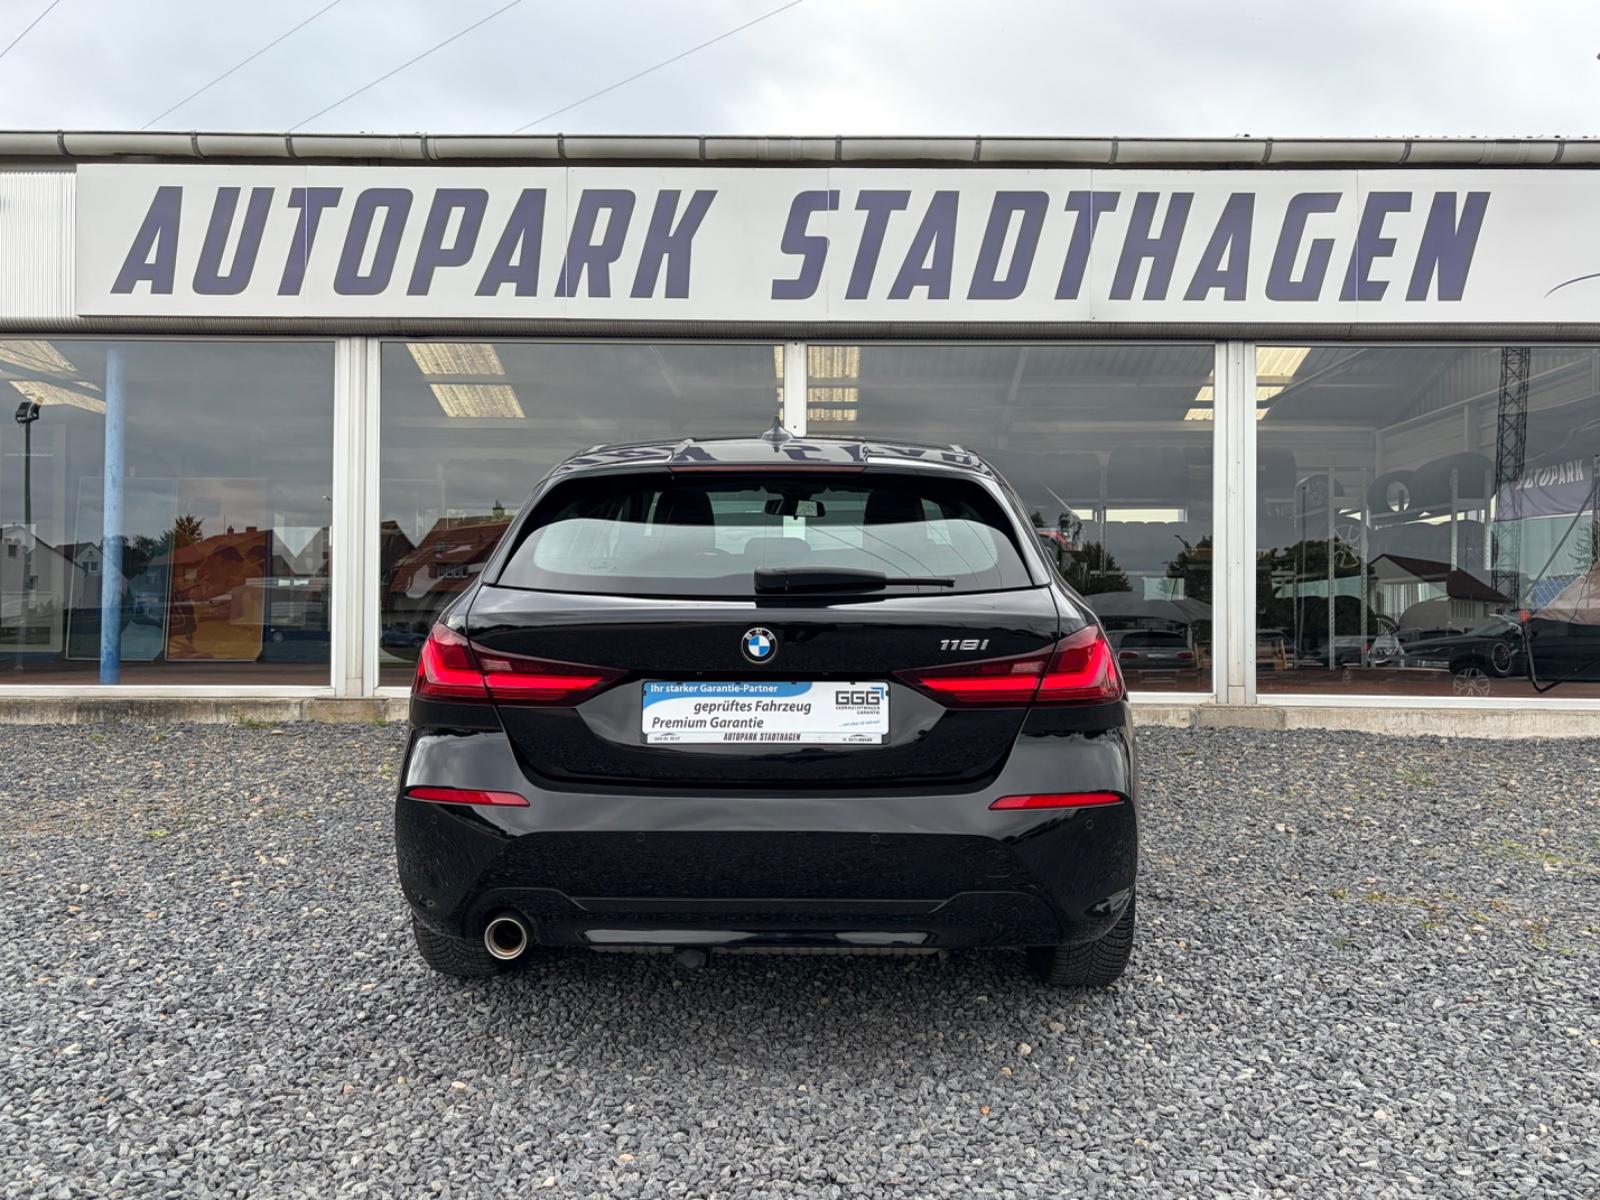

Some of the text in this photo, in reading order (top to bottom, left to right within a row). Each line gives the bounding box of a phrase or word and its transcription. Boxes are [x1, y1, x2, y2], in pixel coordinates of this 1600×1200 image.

[109, 185, 1491, 302] AUTOPARK STADTHAGEN
[650, 684, 778, 692] Ihr starker Garantie-Partner
[835, 690, 880, 705] GGG
[694, 700, 812, 715] geprüftes Fahrzeug
[652, 716, 764, 728] Premium Garantie
[723, 732, 801, 741] AUTOPARK STADTHAGEN
